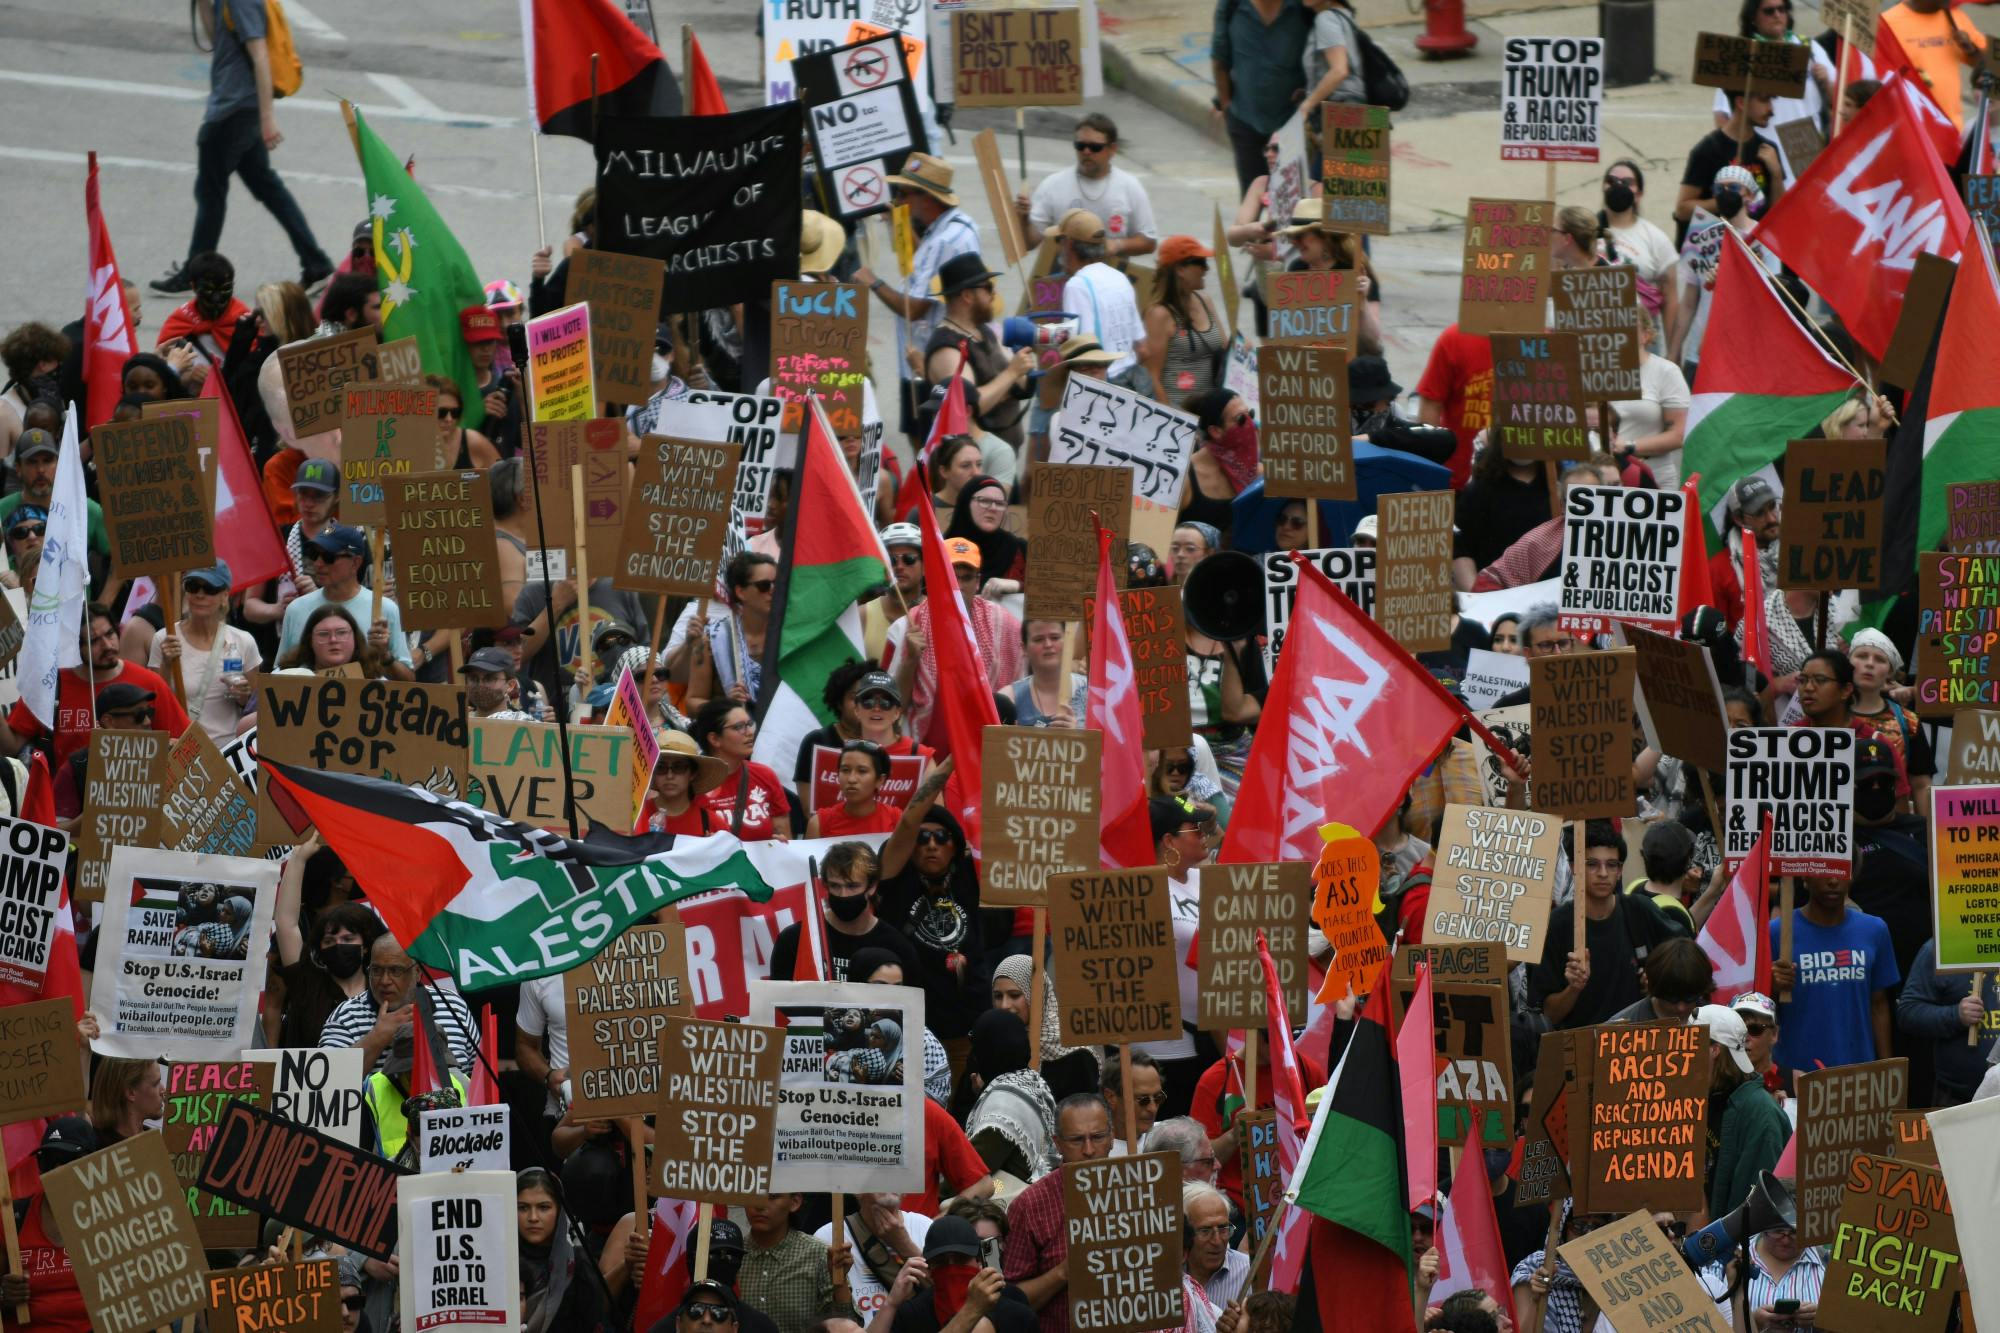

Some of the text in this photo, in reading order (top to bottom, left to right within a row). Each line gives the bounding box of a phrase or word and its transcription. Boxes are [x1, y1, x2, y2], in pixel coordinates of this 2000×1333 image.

[961, 41, 1073, 68] PAST YOUR
[1505, 39, 1600, 62] STOP
[1505, 66, 1600, 98] TRUMP
[1504, 102, 1598, 125] & RACIST
[1504, 125, 1596, 142] REPUBLICANS
[1276, 272, 1345, 304] STOP
[1562, 272, 1629, 291] STAND
[1570, 291, 1623, 309] WITH
[1555, 308, 1637, 329] PALESTINE
[535, 319, 581, 346] I WILL VOTE
[1278, 349, 1320, 372] WE
[1520, 338, 1550, 358] WE
[284, 342, 359, 382] FASCIST
[1266, 376, 1336, 399] CAN NO
[1267, 403, 1337, 426] LONGER
[377, 418, 396, 438] IS
[376, 440, 391, 458] A
[658, 443, 726, 468] STAND
[1269, 432, 1338, 455] AFFORD
[344, 459, 410, 480] UNION
[662, 464, 715, 487] WITH
[1263, 457, 1344, 483] THE RICH
[405, 482, 471, 502] PEACE
[642, 482, 724, 512] PALESTINE
[1801, 468, 1885, 503] LEAD
[1387, 497, 1454, 533] DEFEND
[1568, 487, 1683, 520] STOP
[399, 508, 482, 529] JUSTICE
[648, 512, 708, 536] STOP
[1822, 511, 1865, 540] IN
[120, 541, 209, 566] RIGHTS
[422, 535, 466, 557] AND
[655, 536, 696, 556] THE
[1567, 520, 1680, 562] TRUMP
[409, 562, 483, 585] EQUITY
[628, 553, 712, 582] GENOCIDE
[1563, 561, 1677, 593] & RACIST
[1788, 546, 1876, 582] LOVE
[409, 589, 493, 610] FOR ALL
[1561, 589, 1673, 614] REPUBLICANS
[1942, 632, 1998, 656] STOP
[1543, 656, 1619, 680] STAND
[1948, 658, 1988, 676] THE
[1468, 685, 1498, 696] IS NOT
[1552, 684, 1610, 702] WITH
[99, 736, 158, 759] STAND
[309, 730, 397, 770] for
[1007, 737, 1086, 763] STAND
[1550, 732, 1614, 758] STOP
[1728, 729, 1852, 759] STOP
[104, 760, 150, 781] WITH
[1015, 761, 1077, 783] WITH
[1559, 758, 1605, 779] THE
[1729, 761, 1851, 801] TRUMP
[89, 782, 161, 808] PALESTINE
[996, 783, 1092, 813] PALESTINE
[96, 815, 147, 838] STOP
[1006, 816, 1077, 840] STOP
[1466, 809, 1546, 838] STAND
[1947, 827, 1972, 842] TO
[1013, 839, 1065, 863] THE
[1472, 829, 1534, 854] WITH
[1448, 845, 1546, 881] PALESTINE
[1069, 874, 1154, 901] STAND
[1228, 865, 1280, 891] WE
[1456, 874, 1526, 902] STOP
[142, 911, 175, 928] SAVE
[1079, 901, 1147, 924] WITH
[1214, 894, 1296, 921] CAN NO
[1323, 907, 1370, 928] MAKE MY
[1463, 896, 1513, 920] THE
[128, 929, 171, 948] RAFAH!
[1064, 922, 1167, 953] PALESTINE
[1433, 911, 1532, 950] GENOCIDE
[123, 960, 244, 982] Stop U.S.-Israel
[592, 957, 659, 984] WITH
[1081, 956, 1154, 980] STOP
[1799, 950, 1866, 970] BIDEN
[1801, 968, 1866, 984] HARRIS
[143, 982, 220, 1001] Genocide!
[576, 977, 680, 1014] PALESTINE
[1090, 982, 1145, 1004] THE
[119, 1011, 235, 1028] wibailoutpeople.org
[594, 1015, 666, 1043] STOP
[1069, 1005, 1173, 1036] GENOCIDE
[681, 1025, 768, 1054] STAND
[790, 1038, 823, 1054] SAVE
[1598, 1026, 1700, 1058] FIGHT THE
[603, 1040, 659, 1066] THE
[690, 1052, 756, 1078] WITH
[281, 1049, 330, 1092] NO
[1609, 1052, 1696, 1084] RACIST
[778, 1088, 902, 1108] Stop U.S.-Israel
[1625, 1081, 1666, 1101] AND
[1808, 1068, 1901, 1118] DEFEND
[427, 1111, 504, 1131] END THE
[681, 1109, 758, 1137] STOP
[800, 1108, 880, 1127] Genocide!
[1594, 1097, 1706, 1125] REACTIONARY
[688, 1134, 744, 1162] THE
[777, 1129, 902, 1141] Wisconsin Bail Out The People Movement
[779, 1138, 901, 1155] wibailoutpeople.org
[1593, 1124, 1695, 1151] REPUBLICAN
[1525, 1140, 1548, 1159] LET
[72, 1146, 136, 1191] WE
[663, 1159, 769, 1194] GENOCIDE
[1075, 1159, 1164, 1192] STAND
[1605, 1151, 1695, 1183] AGENDA
[72, 1170, 164, 1229] CAN NO
[1086, 1184, 1155, 1214] WITH
[1519, 1184, 1550, 1201] LIVE
[431, 1198, 483, 1231] END
[1069, 1206, 1176, 1245] PALESTINE
[1876, 1203, 1929, 1237] UP
[82, 1206, 178, 1266] LONGER
[436, 1234, 482, 1261] U.S.
[1087, 1243, 1164, 1275] STOP
[1832, 1222, 1959, 1290] FIGHT
[210, 1260, 332, 1310] FIGHT THE
[432, 1262, 486, 1286] AID TO
[1096, 1269, 1155, 1296] THE
[431, 1287, 488, 1309] ISRAEL
[1847, 1272, 1926, 1316] BACK!
[1074, 1289, 1183, 1330] GENOCIDE
[1638, 1290, 1684, 1329] AND
